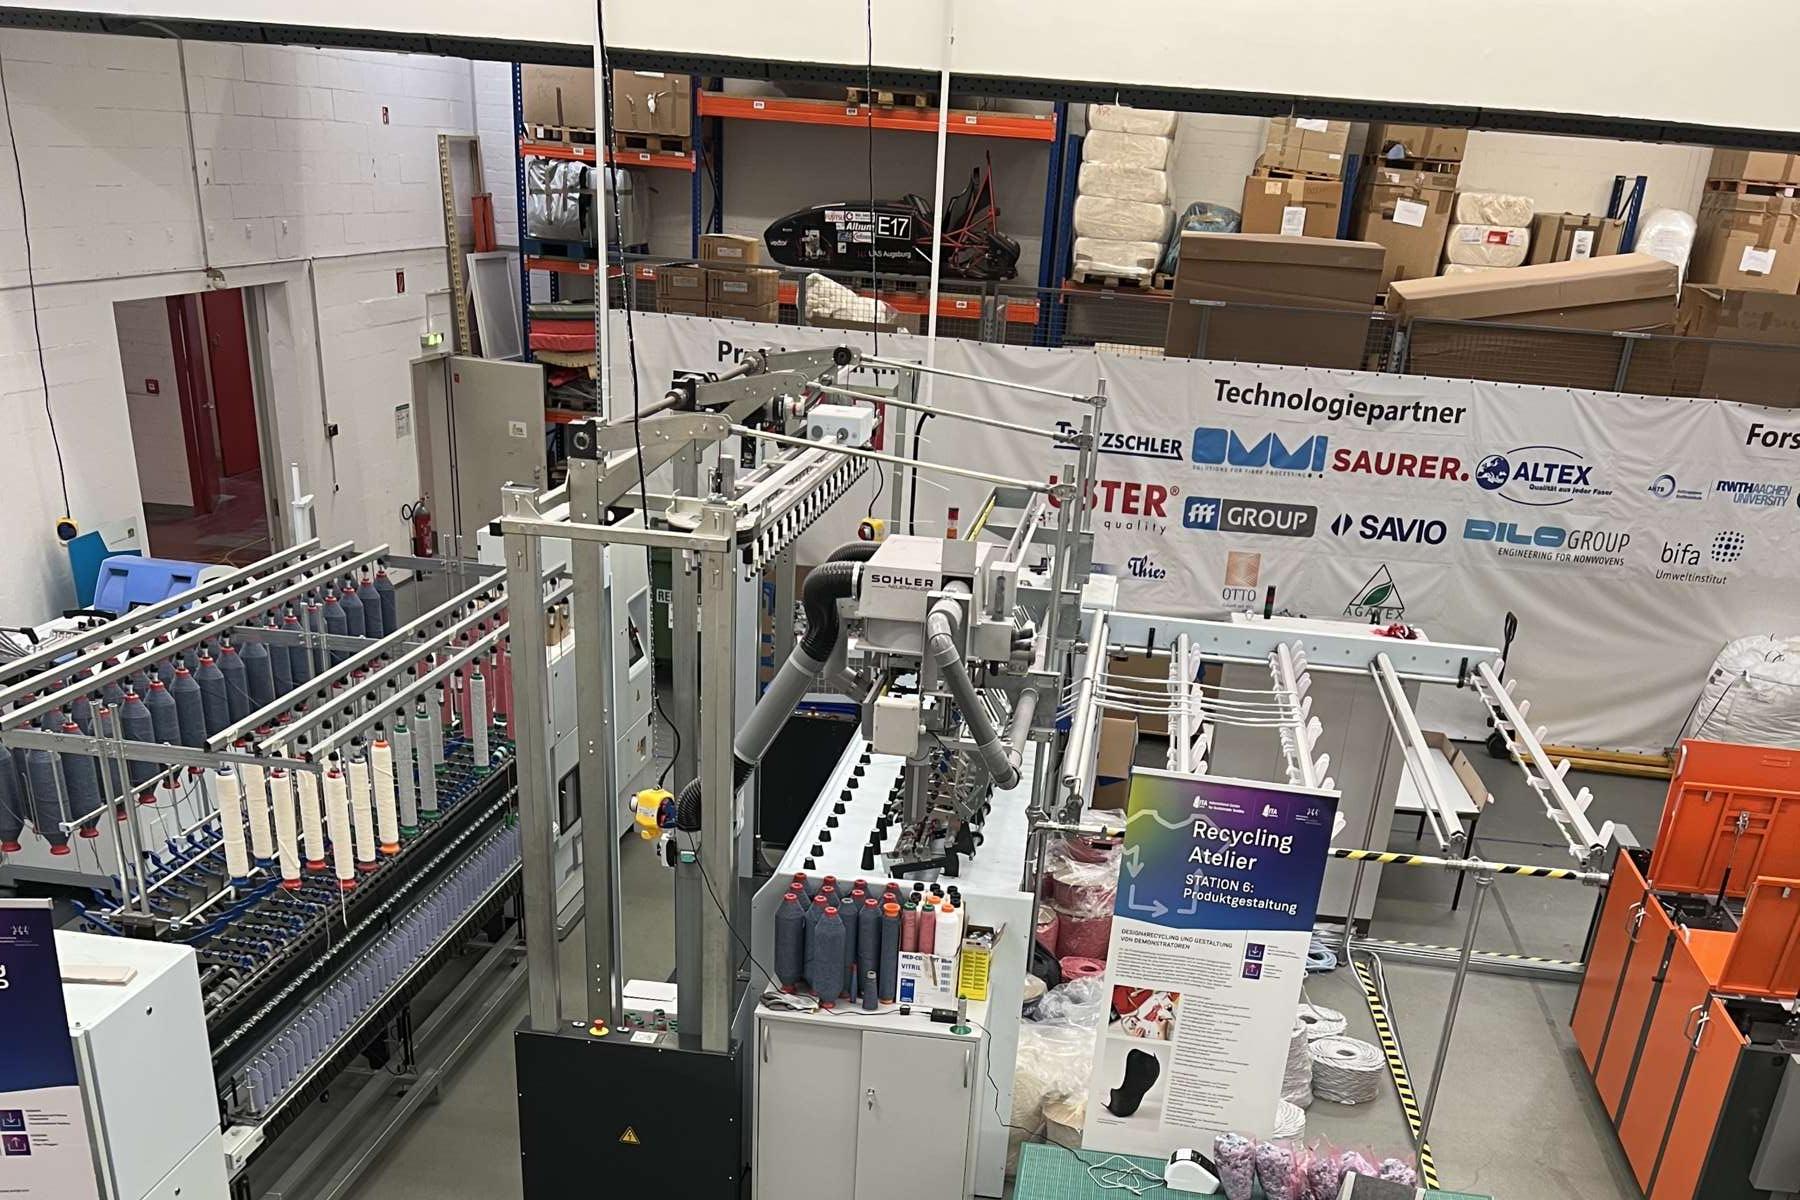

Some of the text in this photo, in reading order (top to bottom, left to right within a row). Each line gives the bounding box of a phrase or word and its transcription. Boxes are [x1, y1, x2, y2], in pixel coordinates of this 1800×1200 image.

[878, 216, 909, 236] E17
[1214, 379, 1466, 425] Technologiepartner
[1055, 421, 1183, 457] TZSCHLER
[1512, 461, 1593, 486] ALTEX
[1733, 492, 1789, 507] UNIVERSITY
[1104, 520, 1166, 535] quality
[1227, 507, 1308, 530] GROUP
[1359, 515, 1447, 545] SAVIO
[1498, 547, 1624, 566] ENGINEERING FOR NONWOVENS
[1661, 541, 1700, 566] bifa
[871, 574, 934, 587] SOHLER
[1655, 569, 1727, 585] Umweltinstitut
[1222, 588, 1257, 602] OTTO
[1193, 820, 1293, 854] Recycling
[1188, 846, 1257, 870] Atelier
[1185, 874, 1254, 893] STATION 6:
[1183, 887, 1298, 916] Produktgestaltung
[1134, 937, 1191, 950] DEMONSTRATOREN
[1194, 938, 1233, 949] GESTALTUNG
